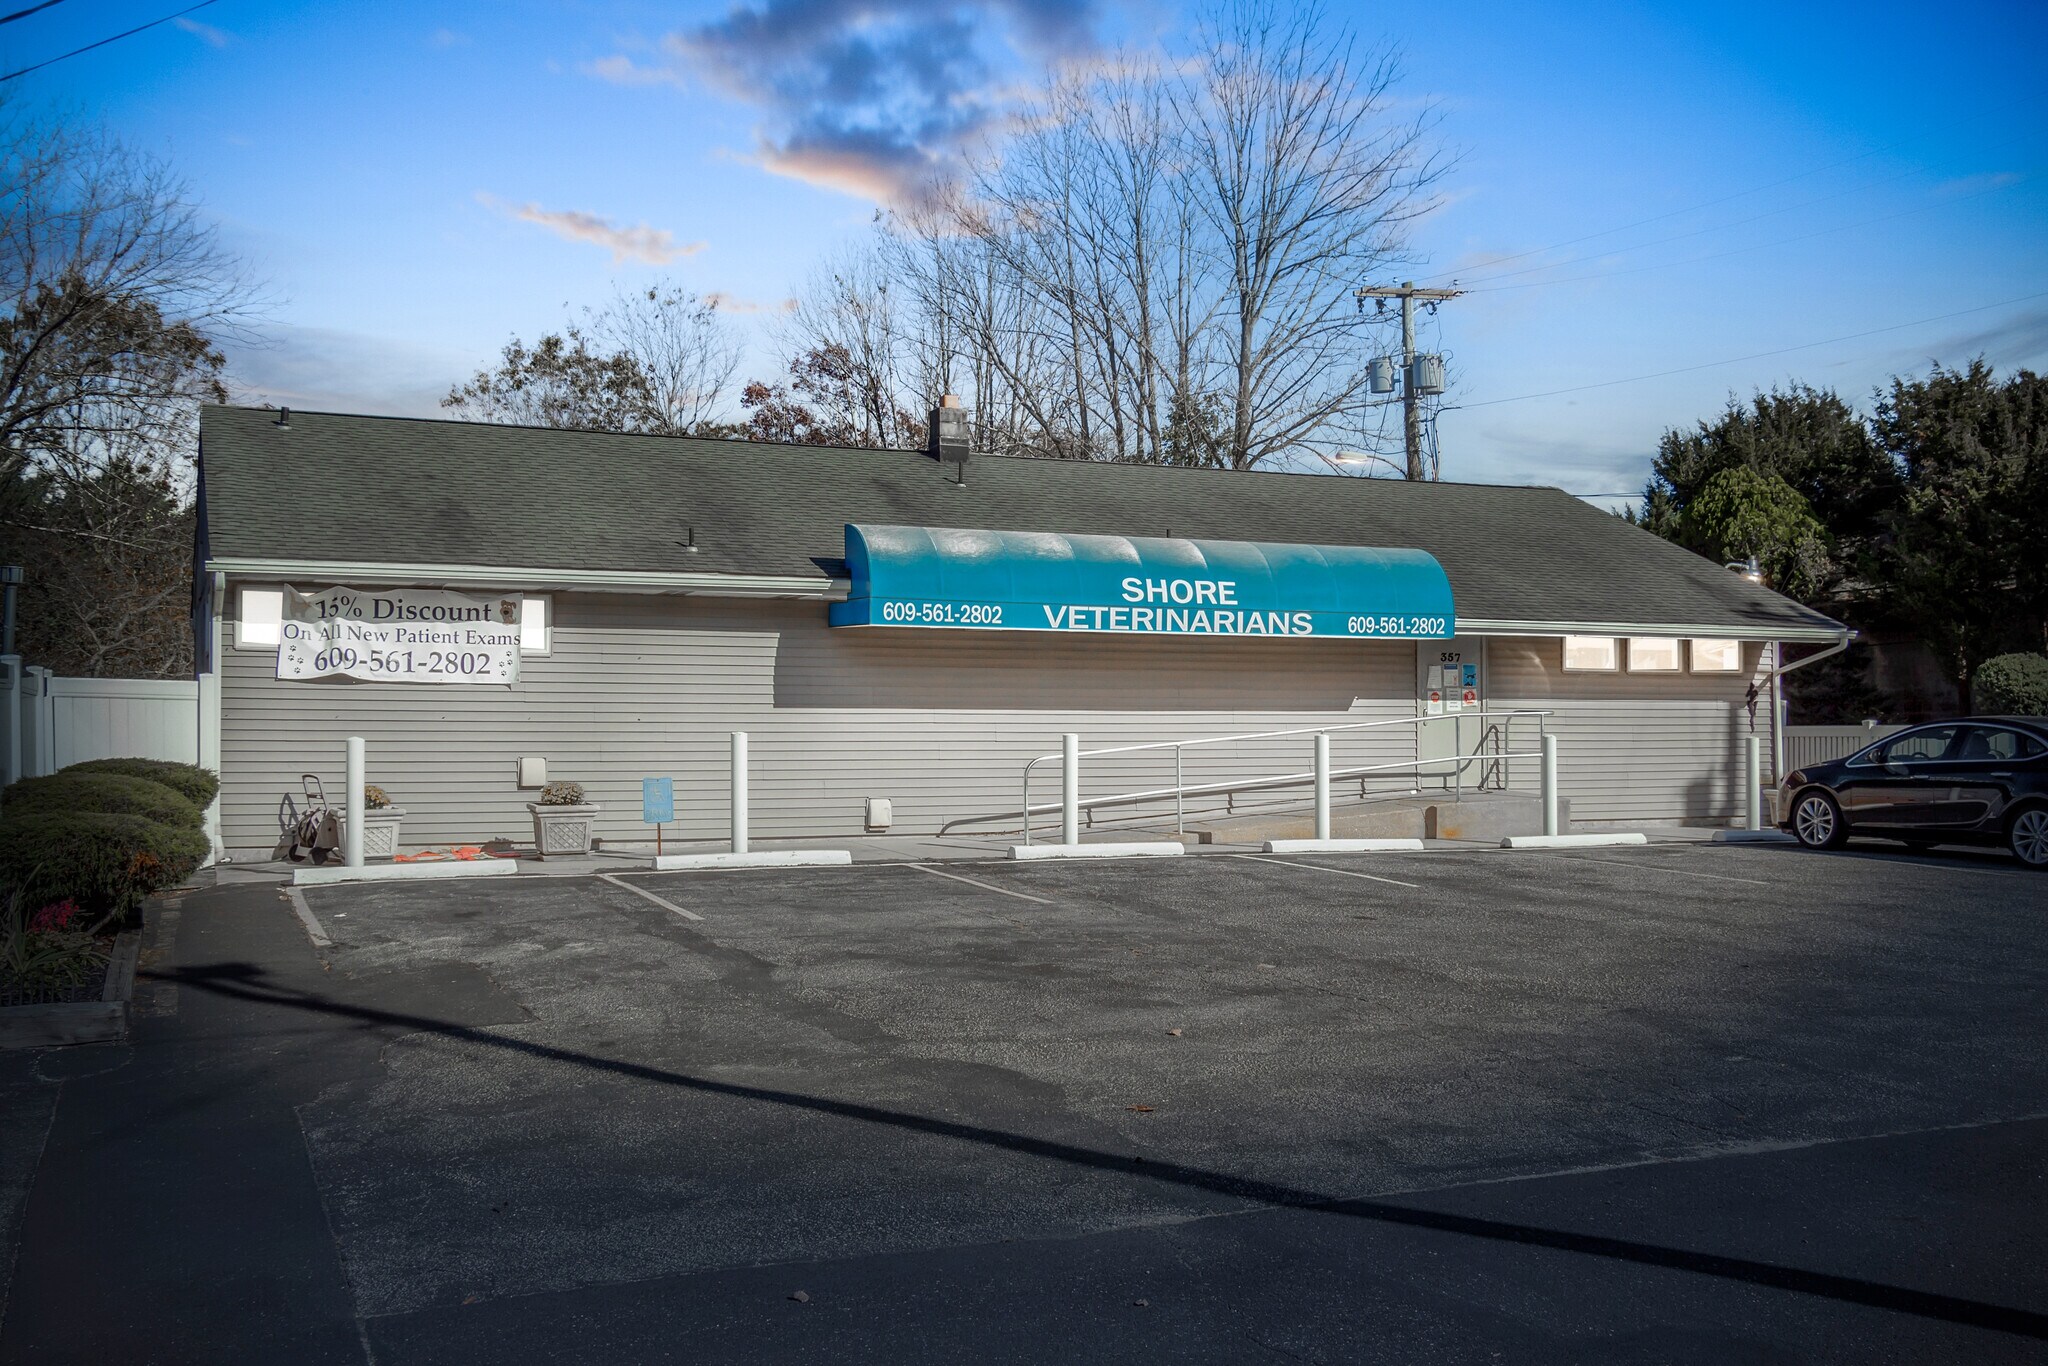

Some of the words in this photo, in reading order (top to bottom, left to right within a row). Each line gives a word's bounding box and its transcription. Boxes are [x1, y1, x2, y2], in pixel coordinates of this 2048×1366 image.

[1121, 577, 1237, 605] SHORE
[315, 595, 362, 619] 15%
[373, 598, 491, 622] Discount
[883, 602, 1002, 624] 609-561-2802
[1043, 605, 1312, 635] VETERINARIANS
[283, 623, 311, 640] On
[319, 624, 340, 640] All
[347, 626, 389, 641] New
[395, 628, 460, 645] Patient
[466, 630, 521, 646] Exams
[1347, 616, 1445, 635] 609-561-2802
[314, 647, 491, 675] 609-561-2802
[1440, 652, 1461, 662] 357
